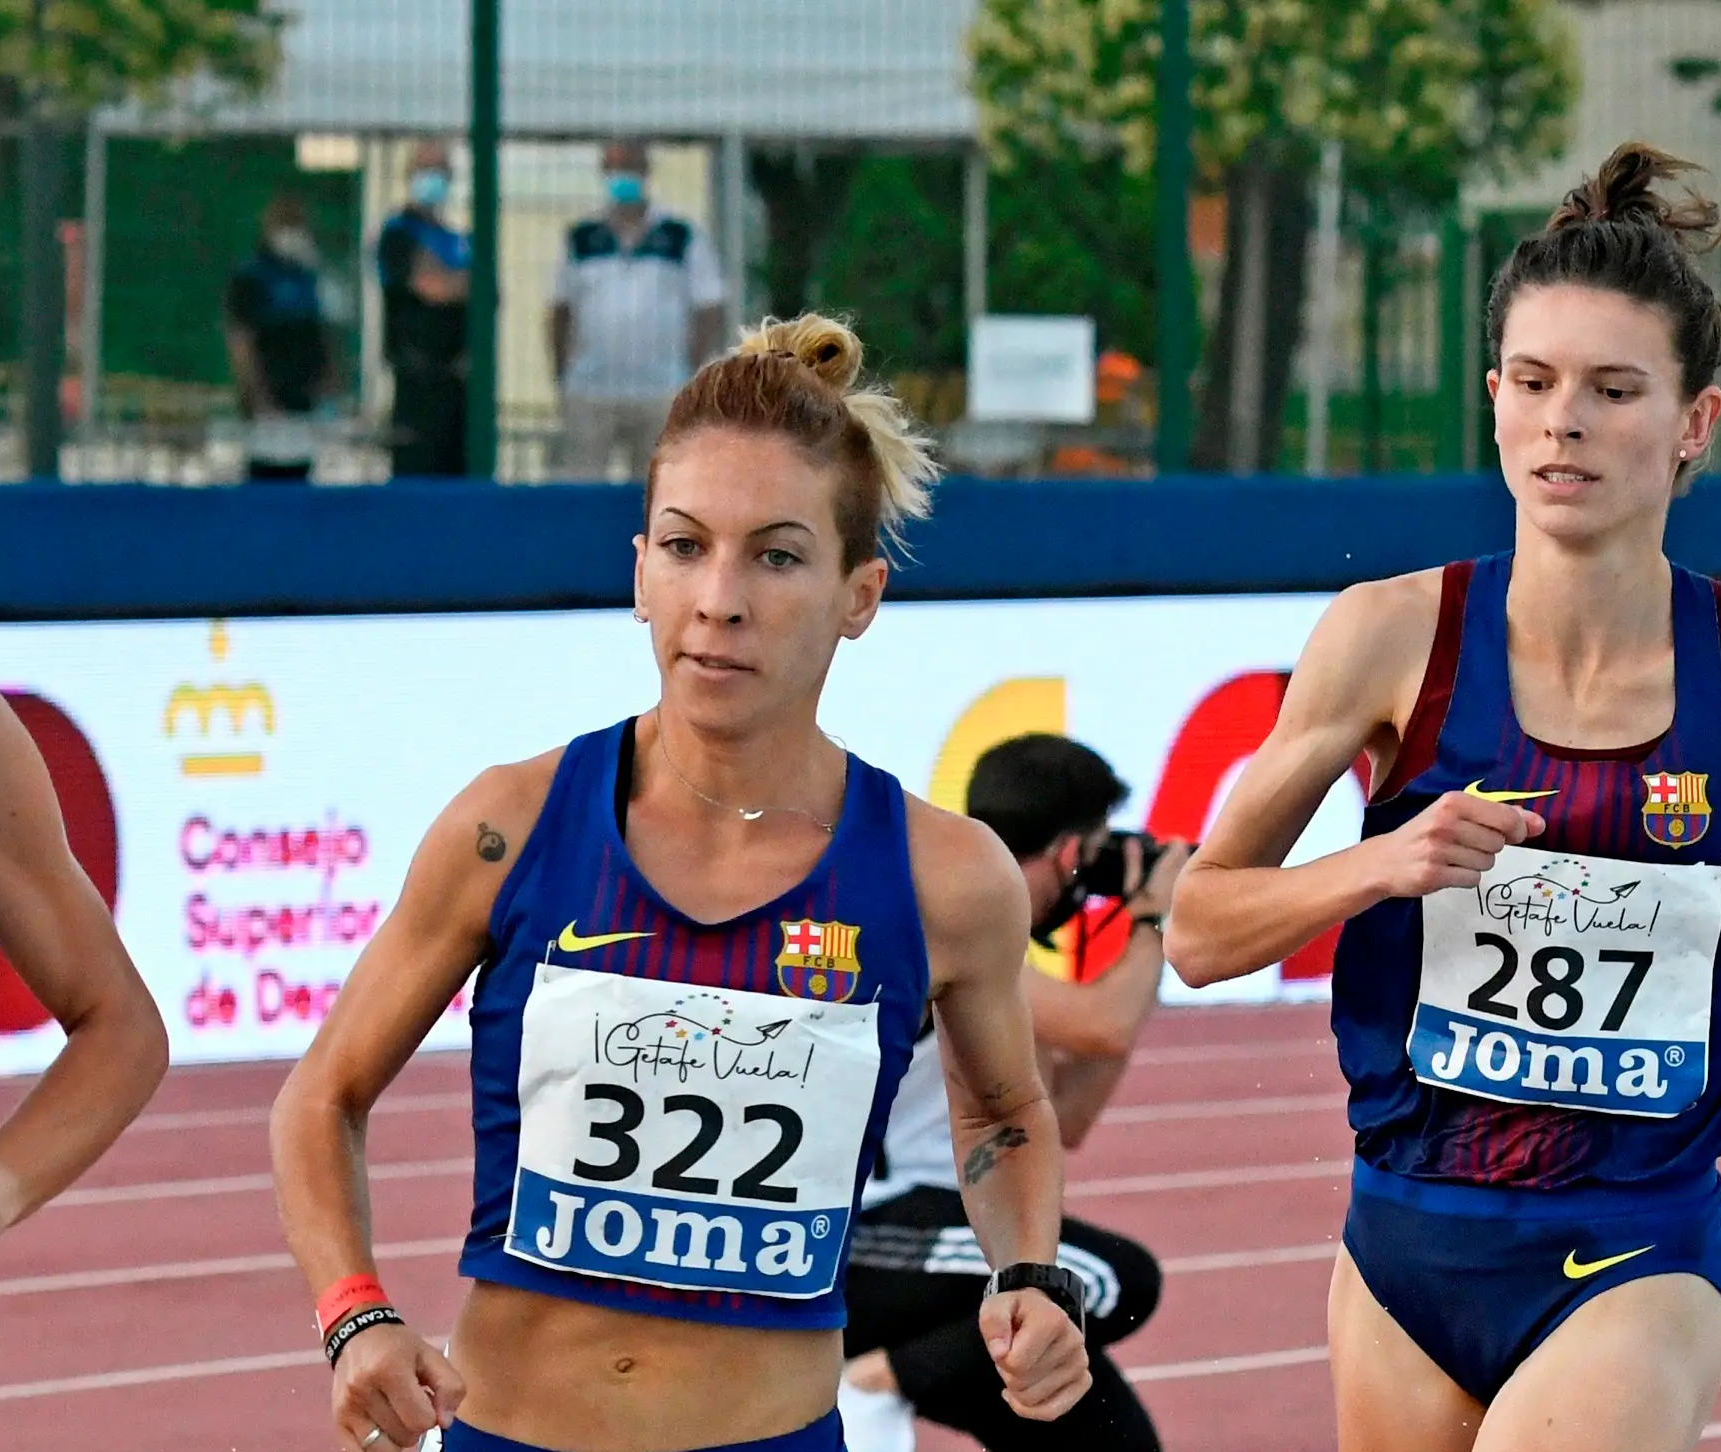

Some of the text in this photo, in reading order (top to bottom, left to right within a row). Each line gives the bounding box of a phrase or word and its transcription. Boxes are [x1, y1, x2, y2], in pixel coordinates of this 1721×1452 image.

[1574, 899, 1661, 937] Vuela!
[1467, 931, 1654, 1032] 287
[714, 1040, 815, 1089] Vuela!
[572, 1083, 803, 1203] 322
[339, 1321, 356, 1339] DO
[356, 1311, 384, 1326] CAN
